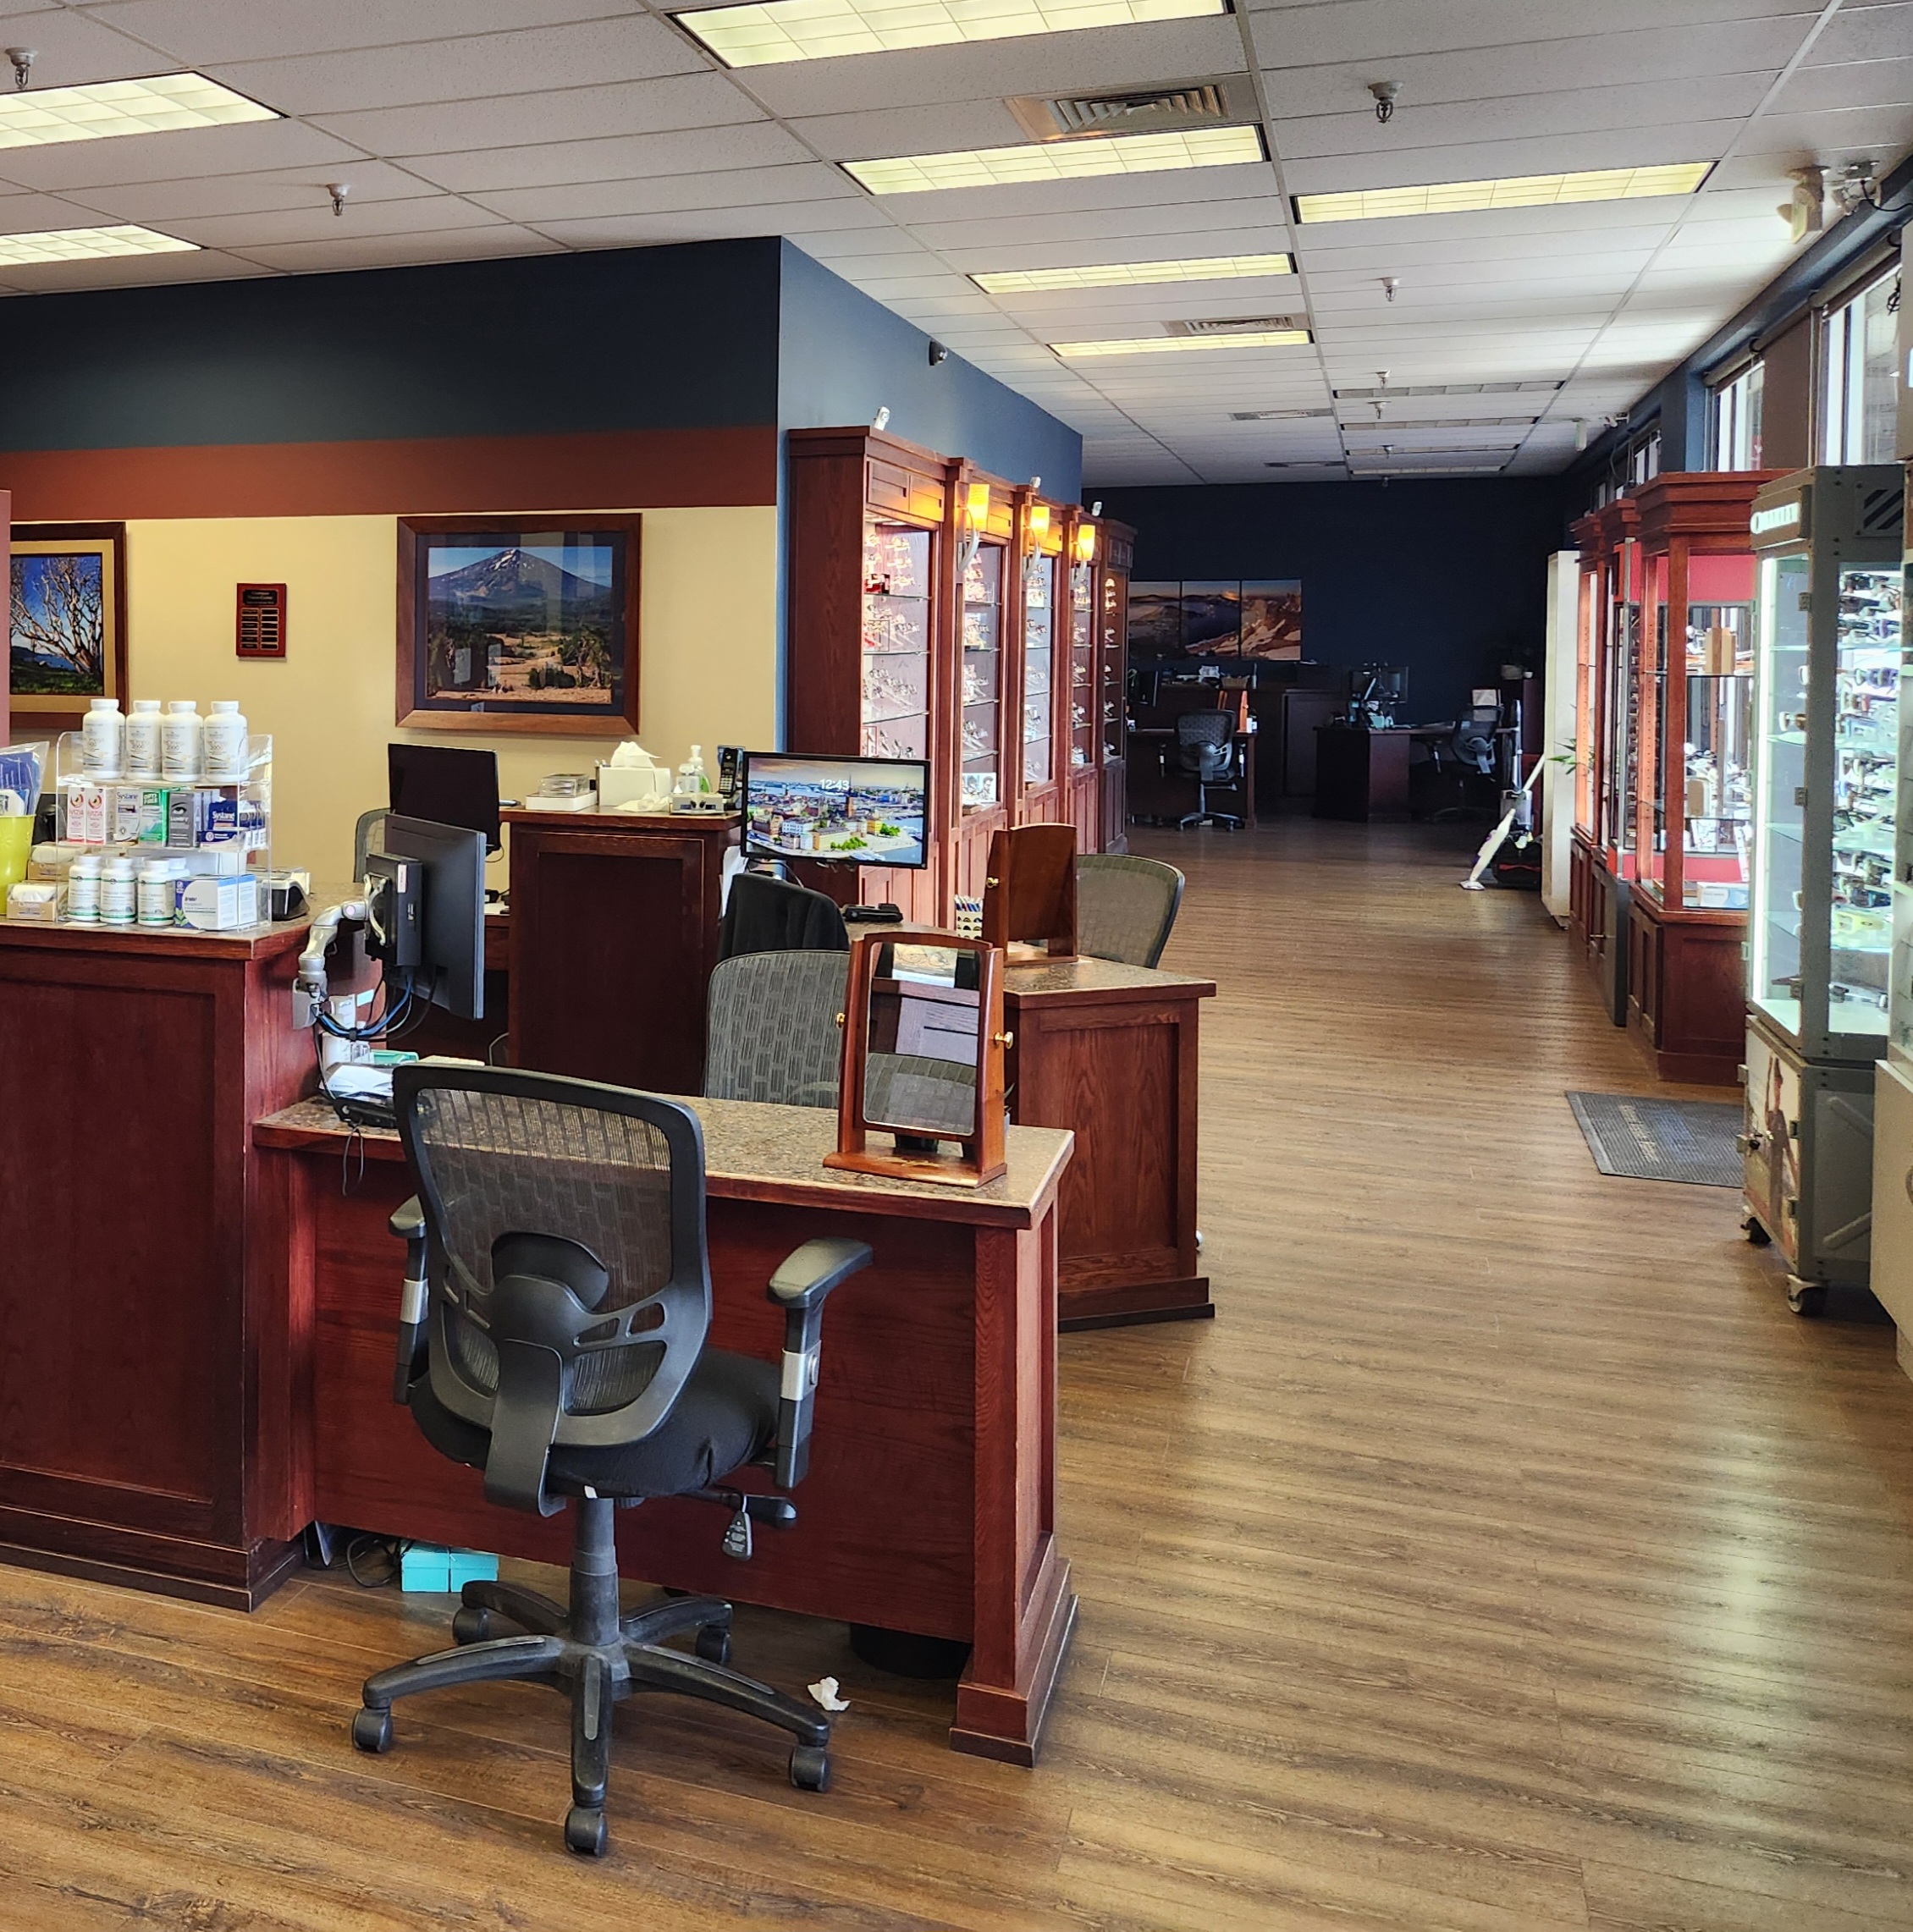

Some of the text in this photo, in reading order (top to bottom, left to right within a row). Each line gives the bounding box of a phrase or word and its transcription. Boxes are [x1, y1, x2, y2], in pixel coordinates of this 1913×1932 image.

[819, 779, 850, 791] 12:43
[117, 791, 138, 802] Systane
[212, 811, 234, 823] Systane
